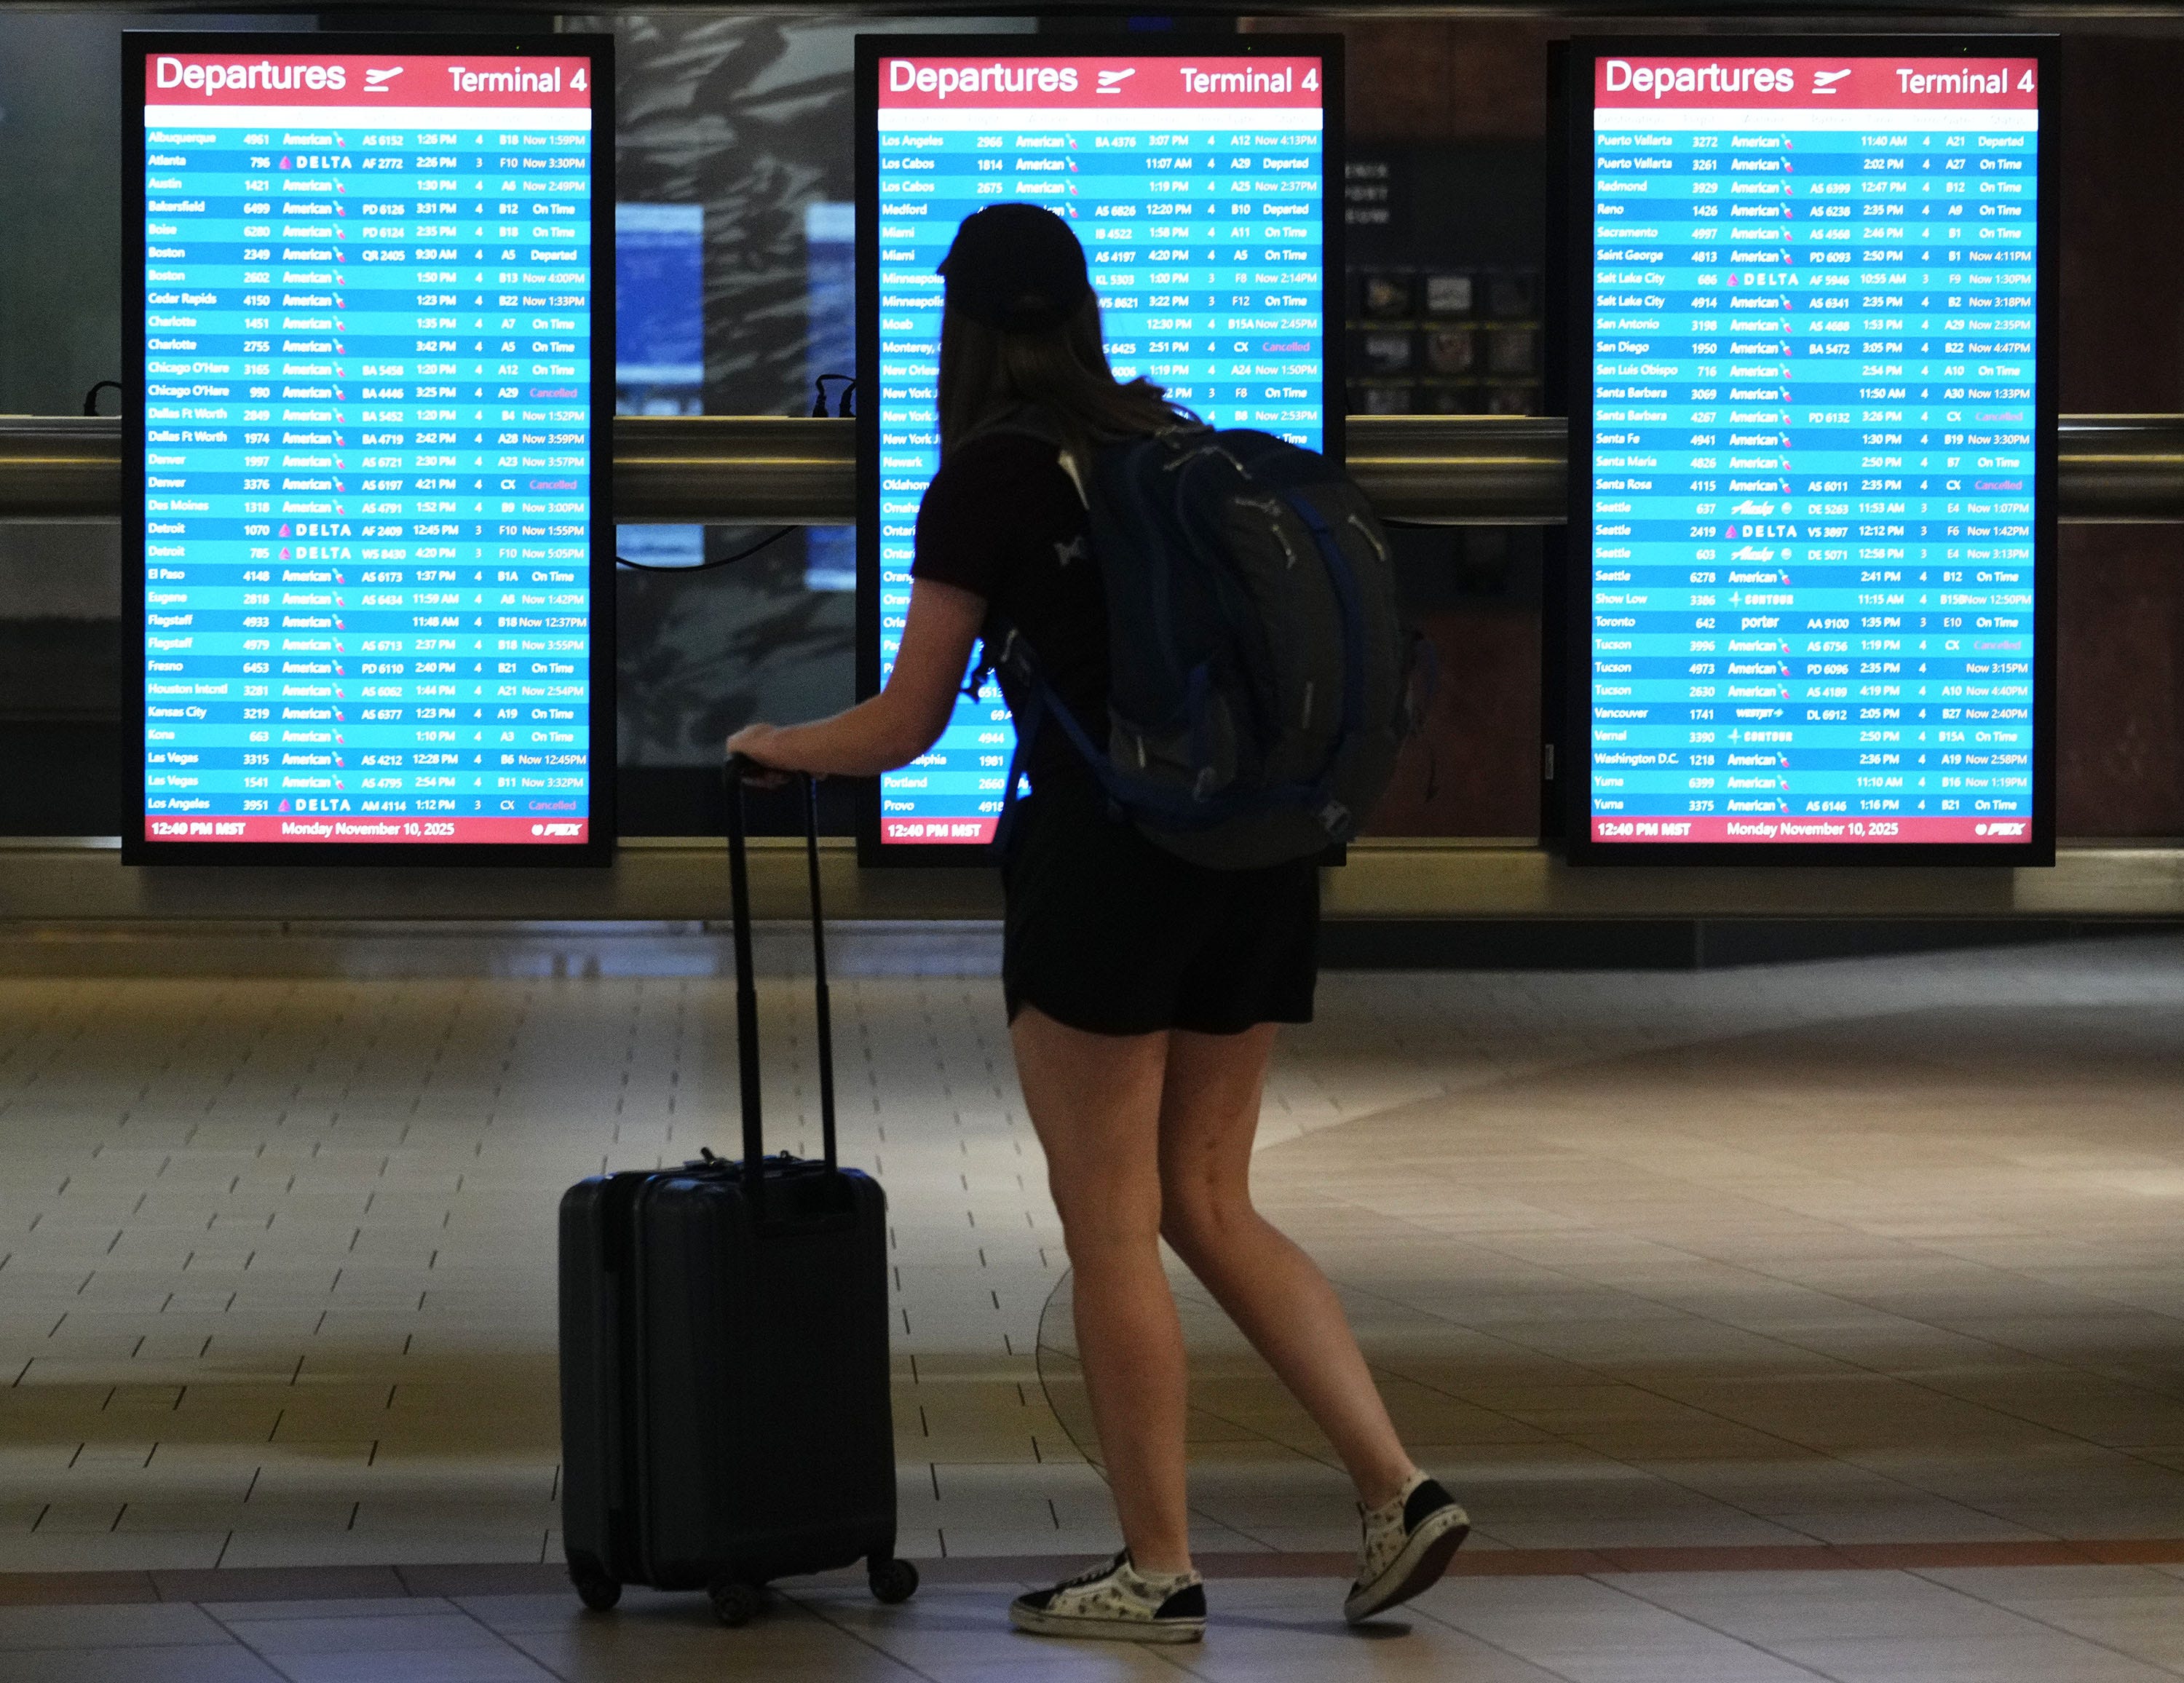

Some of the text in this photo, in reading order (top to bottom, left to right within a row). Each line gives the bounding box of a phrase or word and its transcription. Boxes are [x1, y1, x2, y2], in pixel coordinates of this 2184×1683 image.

[157, 57, 588, 96] Departures Terminal 4
[890, 60, 1319, 100] Departures Terminal 4
[1606, 60, 2035, 100] Departures Terminal 4
[882, 135, 901, 146] Los
[901, 135, 944, 148] Angeles
[1016, 135, 1065, 148] American
[1095, 136, 1110, 148] BA
[1149, 135, 1170, 146] 3:07
[1171, 135, 1189, 146] PM
[1207, 135, 1215, 146] 4
[1230, 135, 1251, 146] A12
[1255, 135, 1278, 146] Now
[1280, 135, 1317, 145] 4:13PM
[148, 154, 186, 166] Atlanta
[296, 155, 352, 169] DELTA
[363, 158, 376, 169] AF
[378, 158, 403, 170] 2772
[416, 157, 438, 168] 2:26
[439, 157, 457, 167] PM
[476, 157, 483, 167] 3
[499, 157, 518, 168] F10
[523, 158, 547, 168] Now
[549, 158, 585, 168] 3:30PM
[882, 157, 1309, 171] Los Cabos 1814 American 11:07 AM 4 A29 Departed
[1597, 157, 2022, 171] Puerto Vallarta 3261 American 2:02 PM 4 A27 On Time
[882, 250, 1307, 263] Miami AS 4197 4:20 PM 4 A5 On Time
[1597, 295, 1617, 306] Salt
[1618, 295, 1643, 306] Lake
[1644, 295, 1666, 309] City
[1690, 297, 1717, 309] 4914
[1730, 296, 1779, 309] American
[1809, 298, 1824, 309] AS
[1862, 296, 1884, 307] 2:35
[1886, 296, 1903, 307] PM
[1921, 296, 1929, 307] 4
[1969, 297, 1993, 307] Now
[1995, 297, 2031, 307] 3:18PM
[148, 430, 181, 442] Dallas
[181, 430, 193, 442] Ft
[194, 430, 228, 442] Worth
[244, 432, 270, 444] 1974
[282, 432, 332, 445] American
[362, 434, 378, 445] BA
[378, 434, 404, 445] 4719
[416, 432, 438, 443] 2:42
[439, 432, 456, 443] PM
[475, 433, 483, 443] 4
[522, 434, 546, 444] Now
[548, 434, 585, 444] 3:59PM
[1595, 615, 2019, 631] Toronto 642 porter AA 9100 1:35 PM 3 E10 On Time
[148, 706, 574, 720] Kansas City 3219 American AS 6377 1:23 PM 4 A19 On Time
[884, 777, 928, 788] Portland
[148, 798, 167, 809] Los
[167, 798, 210, 812] Angeles
[296, 799, 351, 812] DELTA
[361, 801, 380, 811] AM
[381, 801, 407, 812] 4114
[416, 799, 437, 810] 1:12
[438, 799, 456, 810] PM
[475, 800, 481, 810] 3
[500, 800, 515, 810] CX
[529, 801, 577, 810] Cancelled
[1595, 799, 2017, 812] Yuma 3375 American AS 6146 1:16 PM 4 B21 On Time
[151, 822, 246, 836] 12:40 PM MST
[282, 822, 455, 839] Monday November 10, 2025
[887, 823, 982, 837] 12:40 PM MST
[1598, 823, 1692, 836] 12:40 PM MST
[1727, 822, 1899, 839] Monday November 10, 2025
